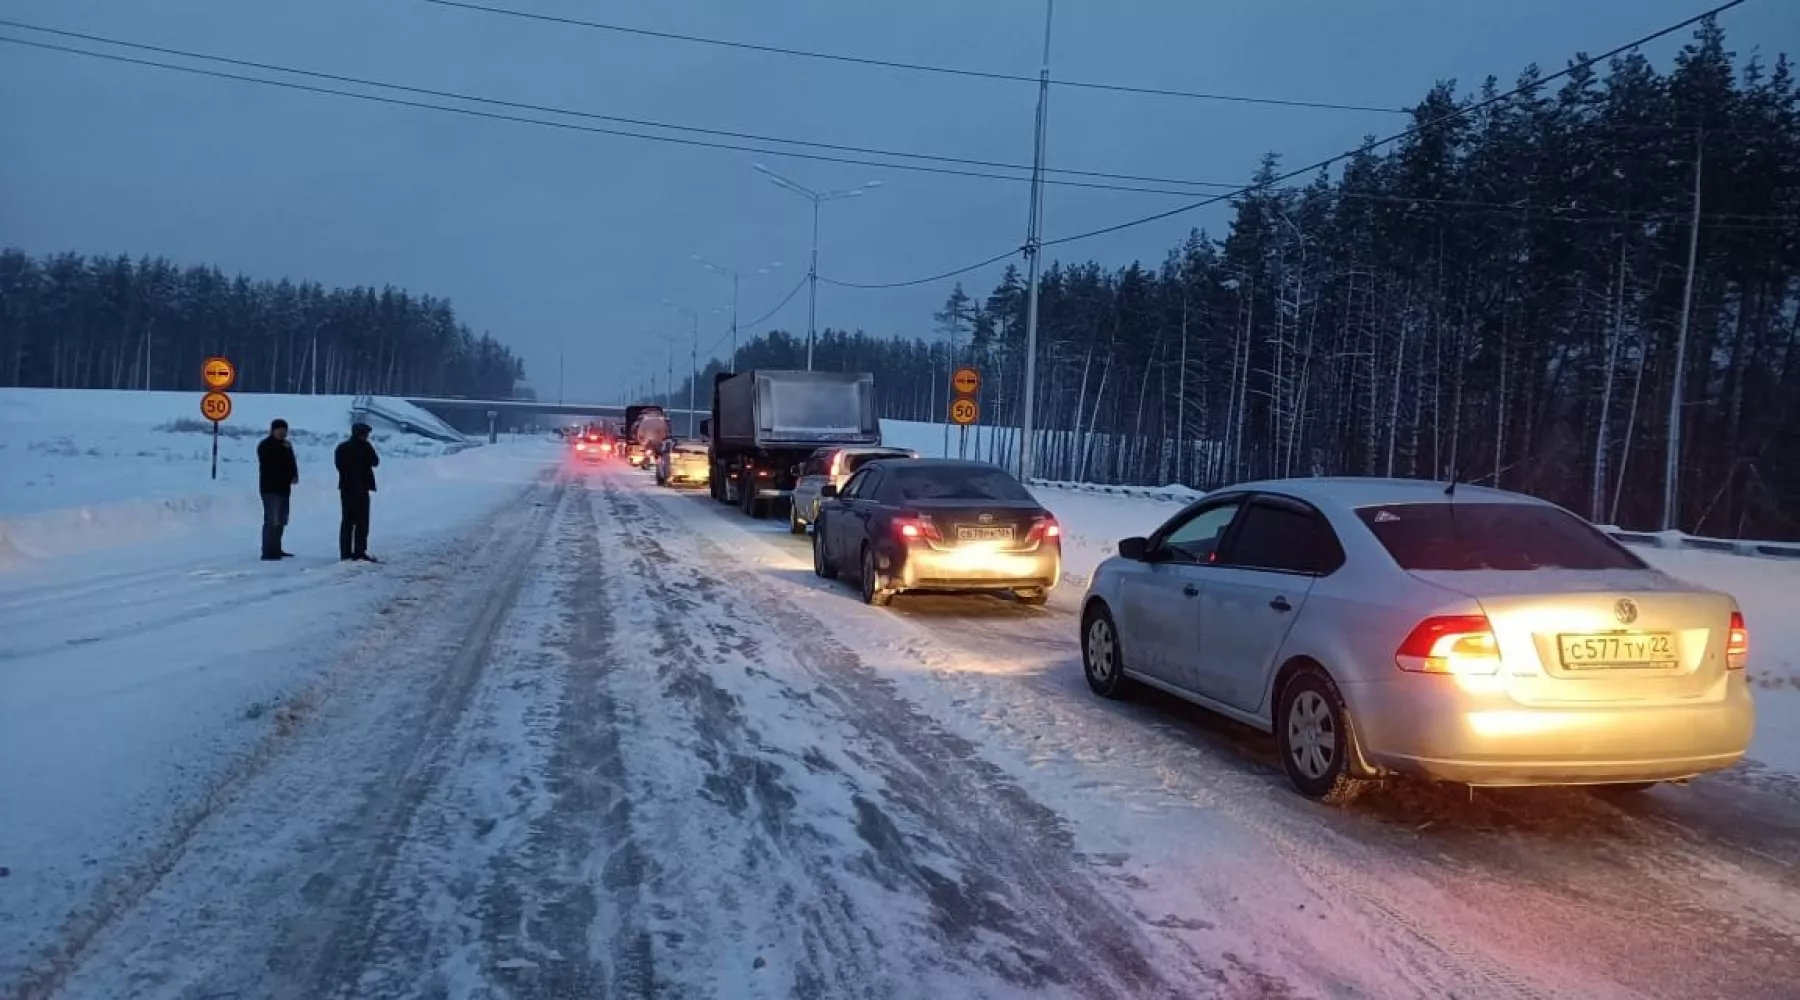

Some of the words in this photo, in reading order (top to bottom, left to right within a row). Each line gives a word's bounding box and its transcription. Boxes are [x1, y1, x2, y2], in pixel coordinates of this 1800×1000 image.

[207, 399, 226, 413] 50
[955, 405, 973, 418] 50
[1650, 636, 1670, 653] 22
